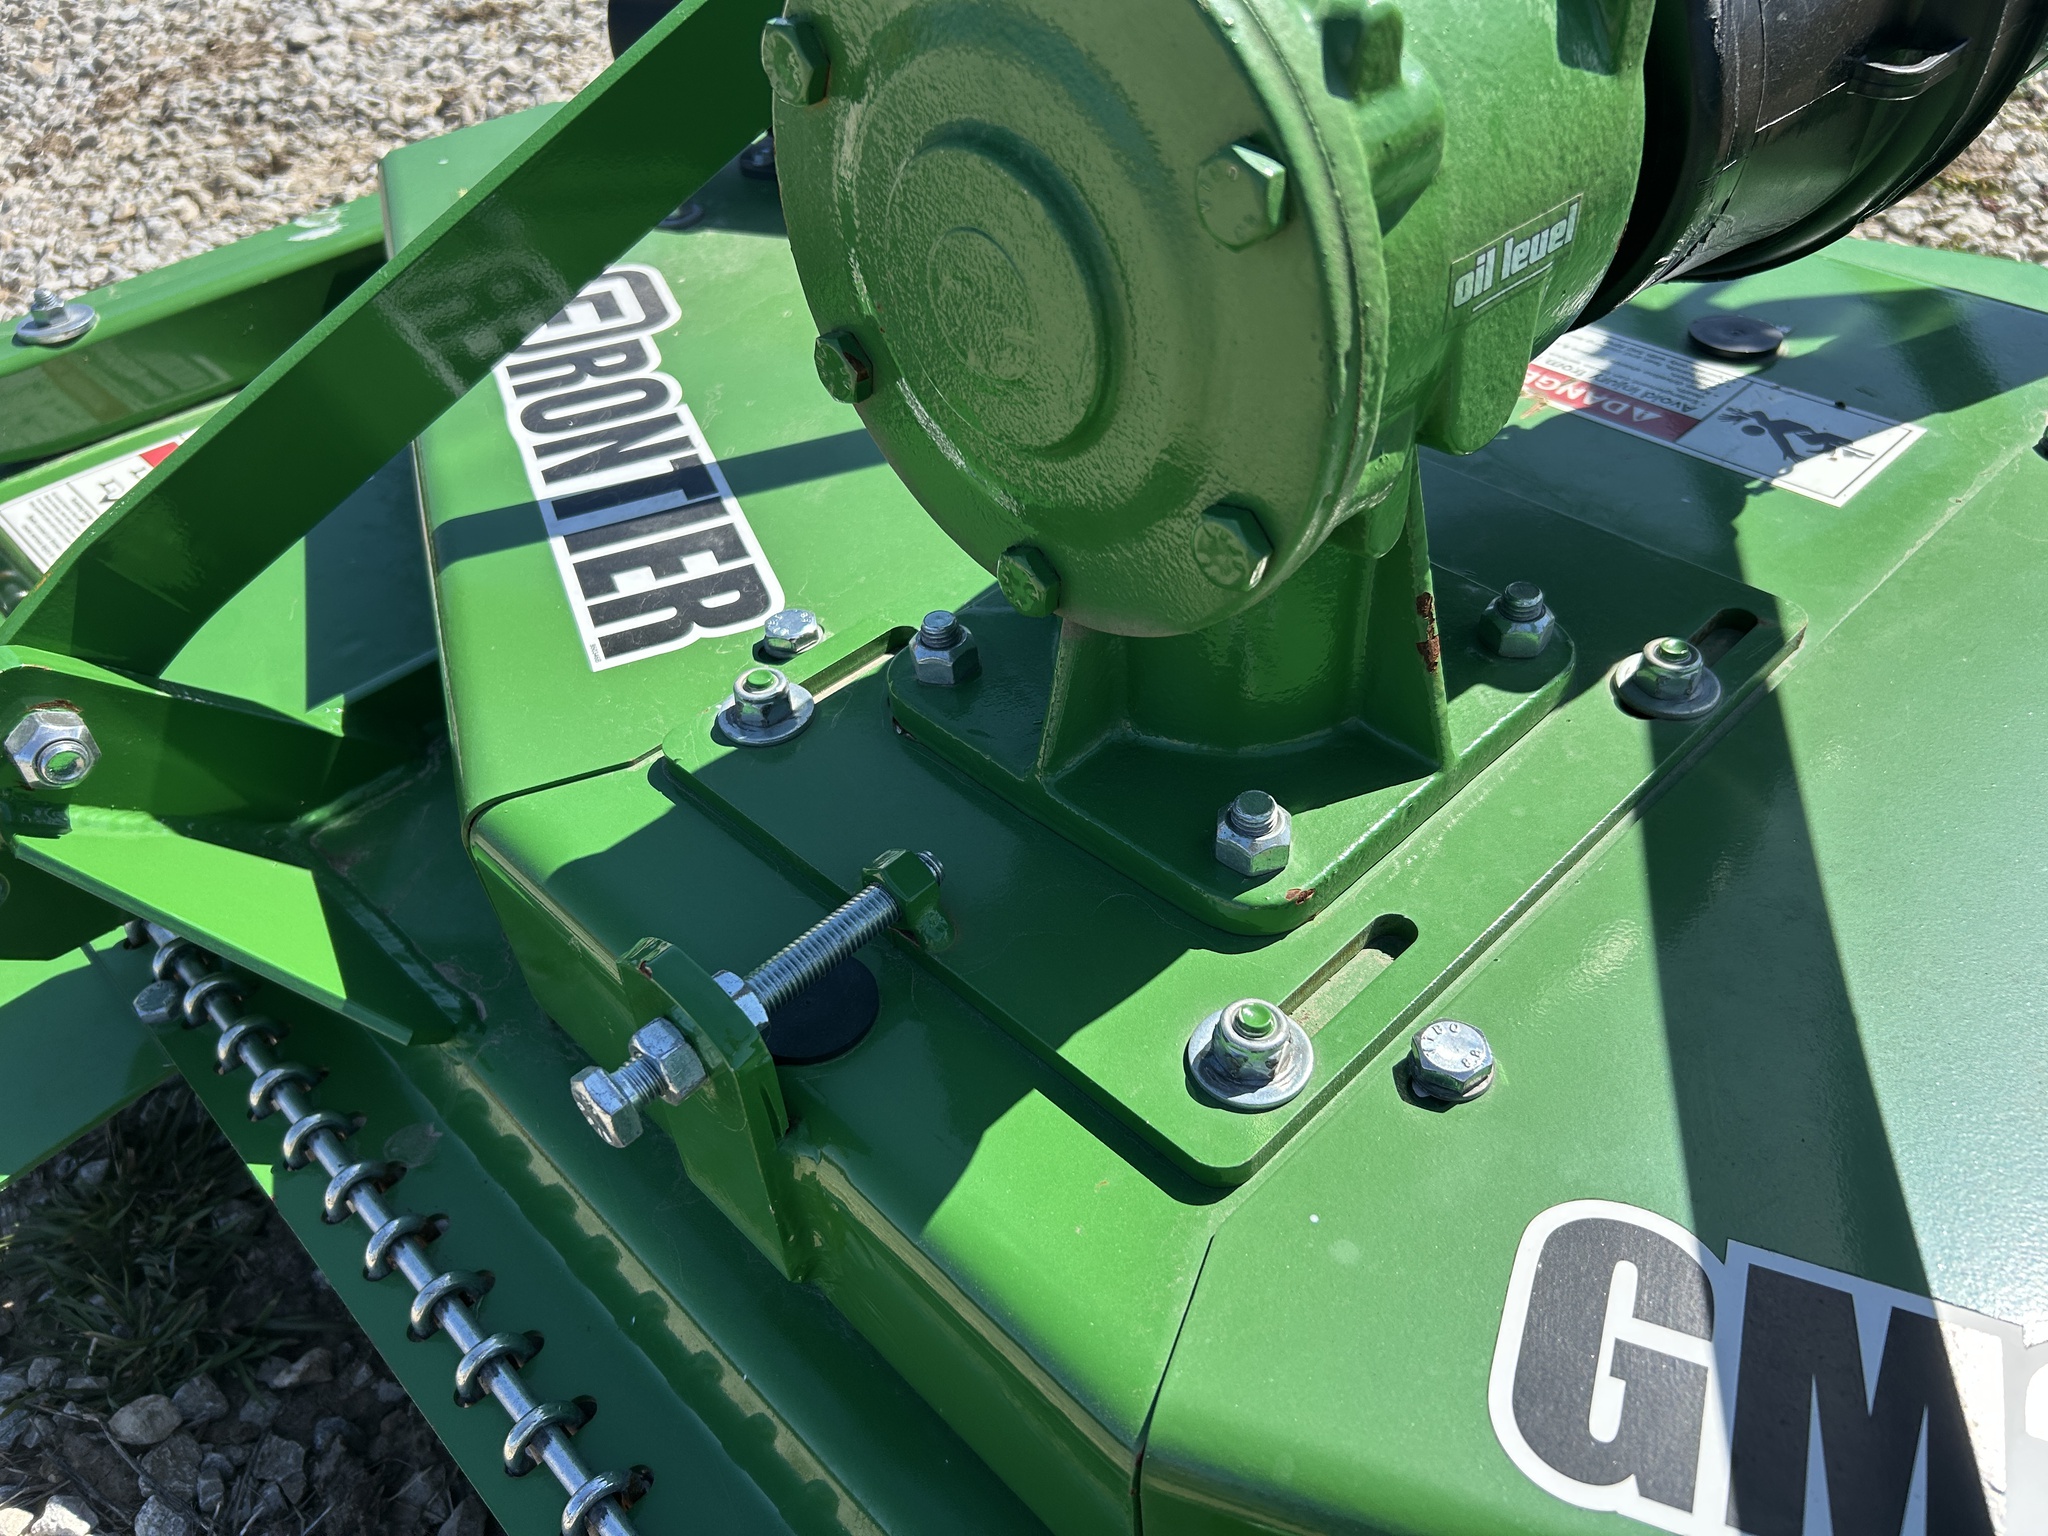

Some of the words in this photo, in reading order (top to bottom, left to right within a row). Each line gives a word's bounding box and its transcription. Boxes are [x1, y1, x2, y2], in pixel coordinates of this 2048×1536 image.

[1453, 246, 1497, 308] oil
[1500, 202, 1579, 281] level
[1525, 370, 1631, 415] DANGE
[1640, 390, 1697, 413] Avoid
[1512, 1217, 2048, 1536] GM
